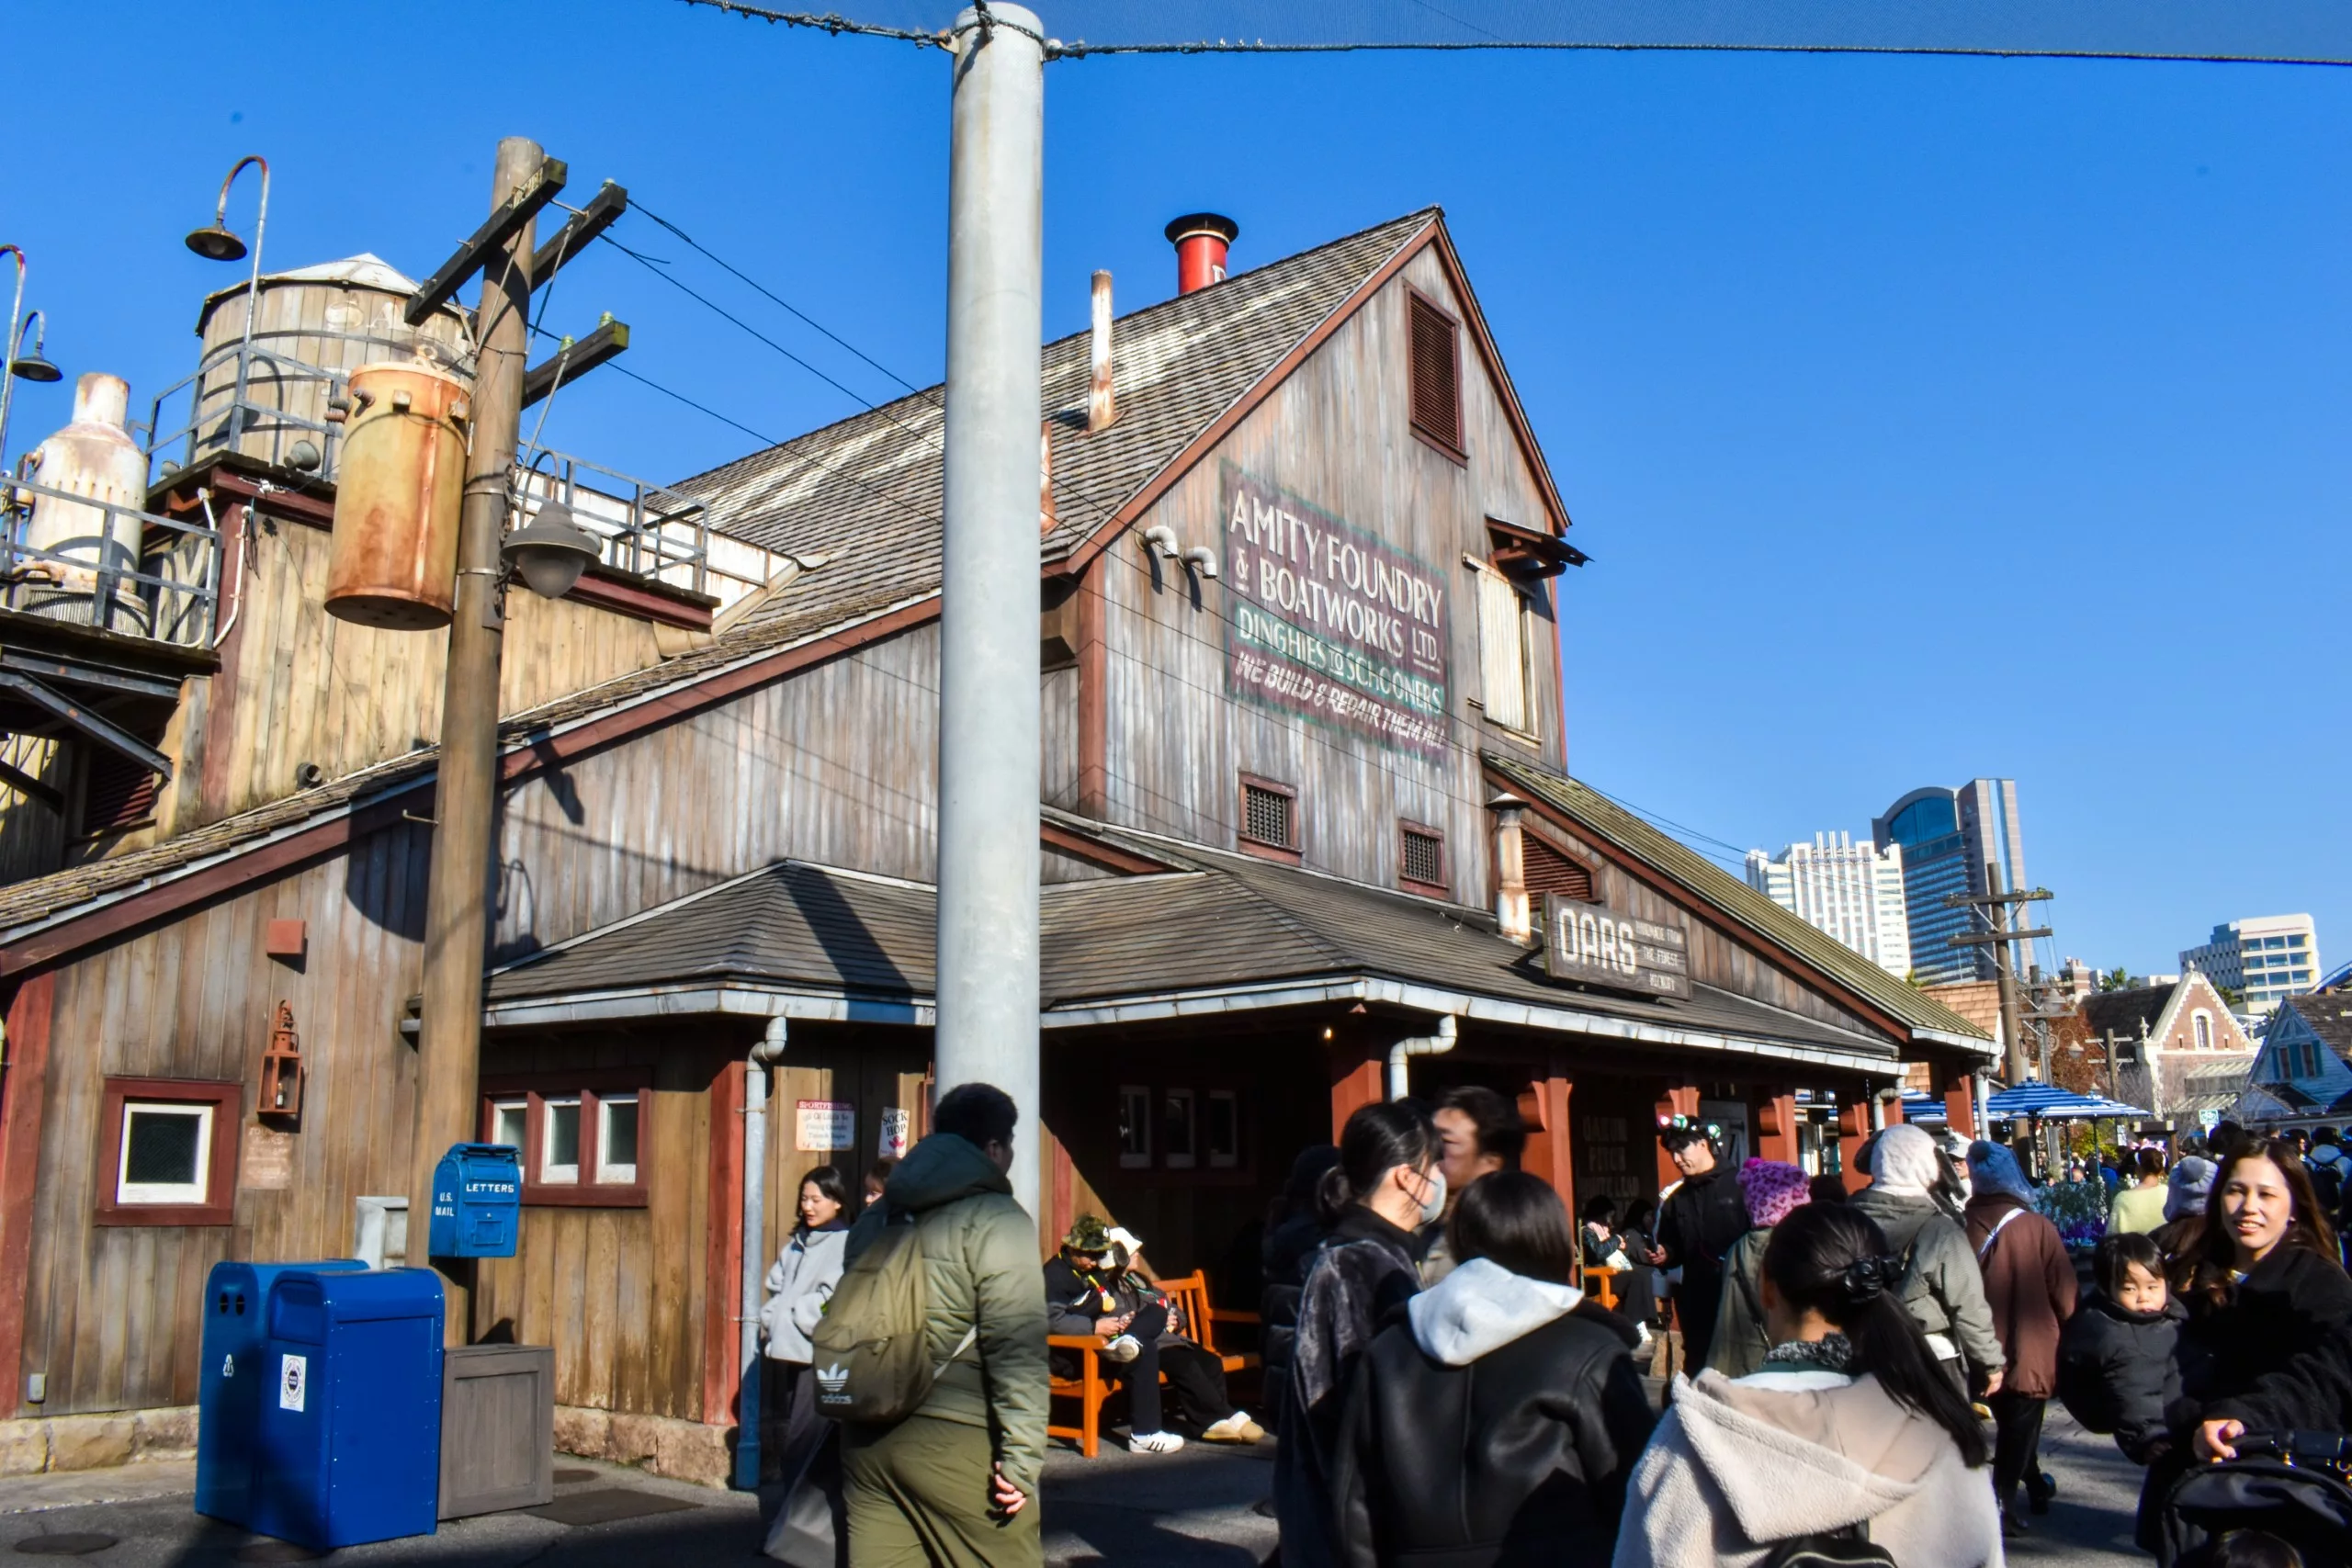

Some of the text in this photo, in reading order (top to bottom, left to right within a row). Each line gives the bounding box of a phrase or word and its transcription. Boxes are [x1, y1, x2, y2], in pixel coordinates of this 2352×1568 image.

[1230, 490, 1442, 629] AMITY FOUNDRY
[1235, 548, 1250, 582] &
[1260, 557, 1405, 659] BOATWORKS
[1238, 608, 1328, 671] DINGHIES
[1346, 652, 1442, 715] SCHOONERS
[1236, 651, 1262, 683] WE
[1264, 667, 1315, 701] BUILD
[1327, 687, 1387, 728] REPAIR
[1384, 706, 1423, 740] THEM
[1558, 908, 1635, 975] OARS
[799, 1100, 854, 1110] SPORTFISHING
[882, 1112, 908, 1125] SOCK
[887, 1123, 906, 1136] HOP
[466, 1183, 514, 1193] LETTERS
[439, 1192, 453, 1201] U.S.
[435, 1206, 454, 1217] MAIL
